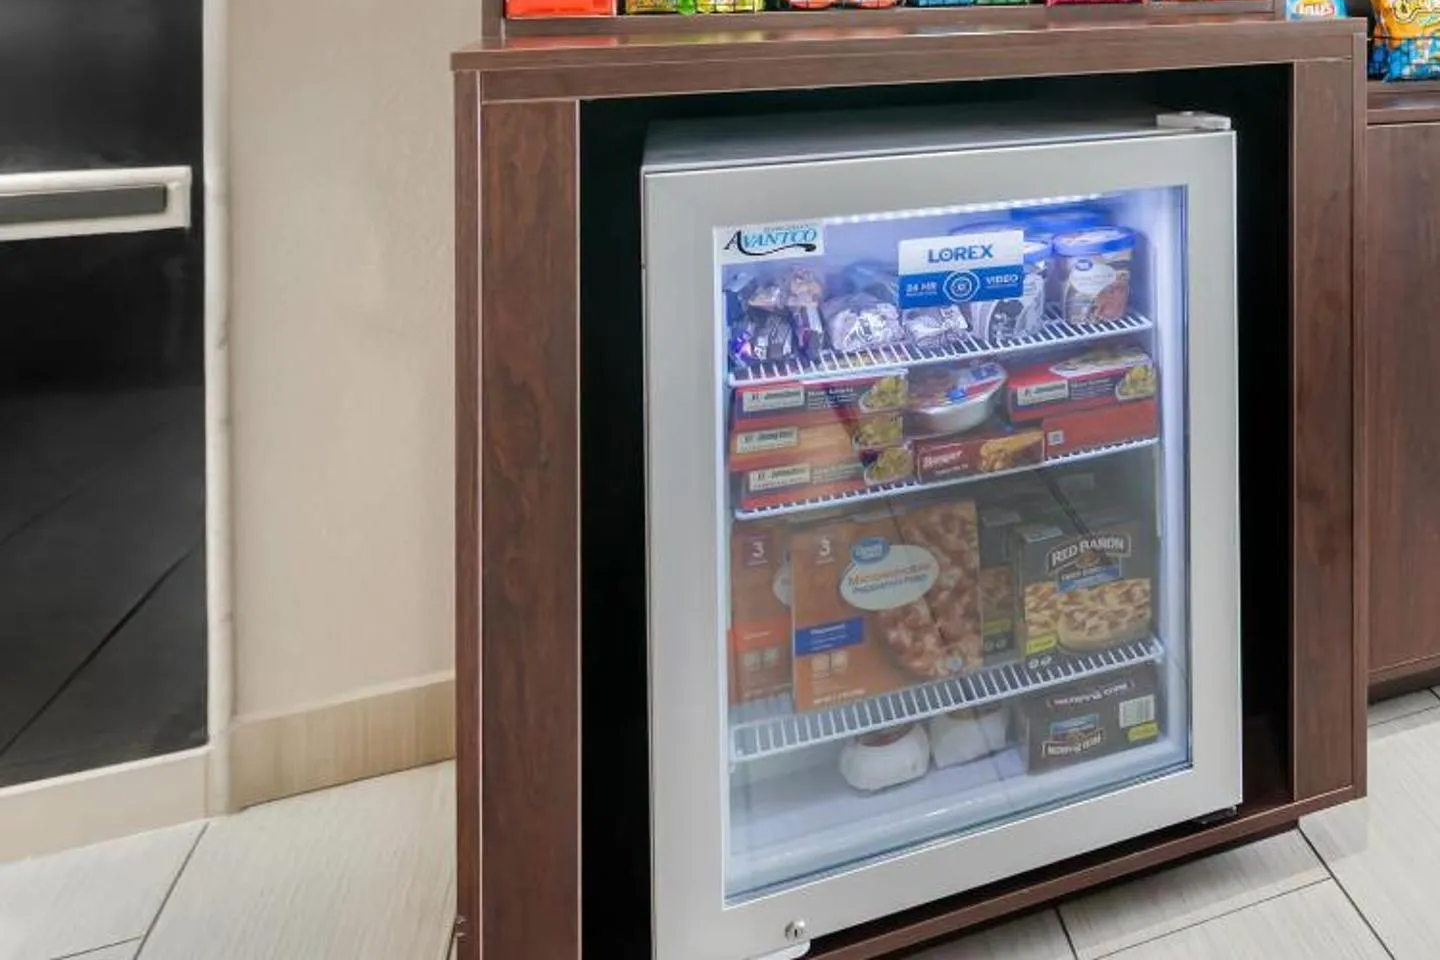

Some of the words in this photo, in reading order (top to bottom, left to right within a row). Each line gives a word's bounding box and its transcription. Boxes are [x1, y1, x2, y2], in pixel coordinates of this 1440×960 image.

[927, 243, 994, 264] LOREX
[985, 273, 1019, 285] VIDEO
[751, 541, 765, 558] 3
[818, 539, 831, 556] 3
[1051, 546, 1079, 567] RED
